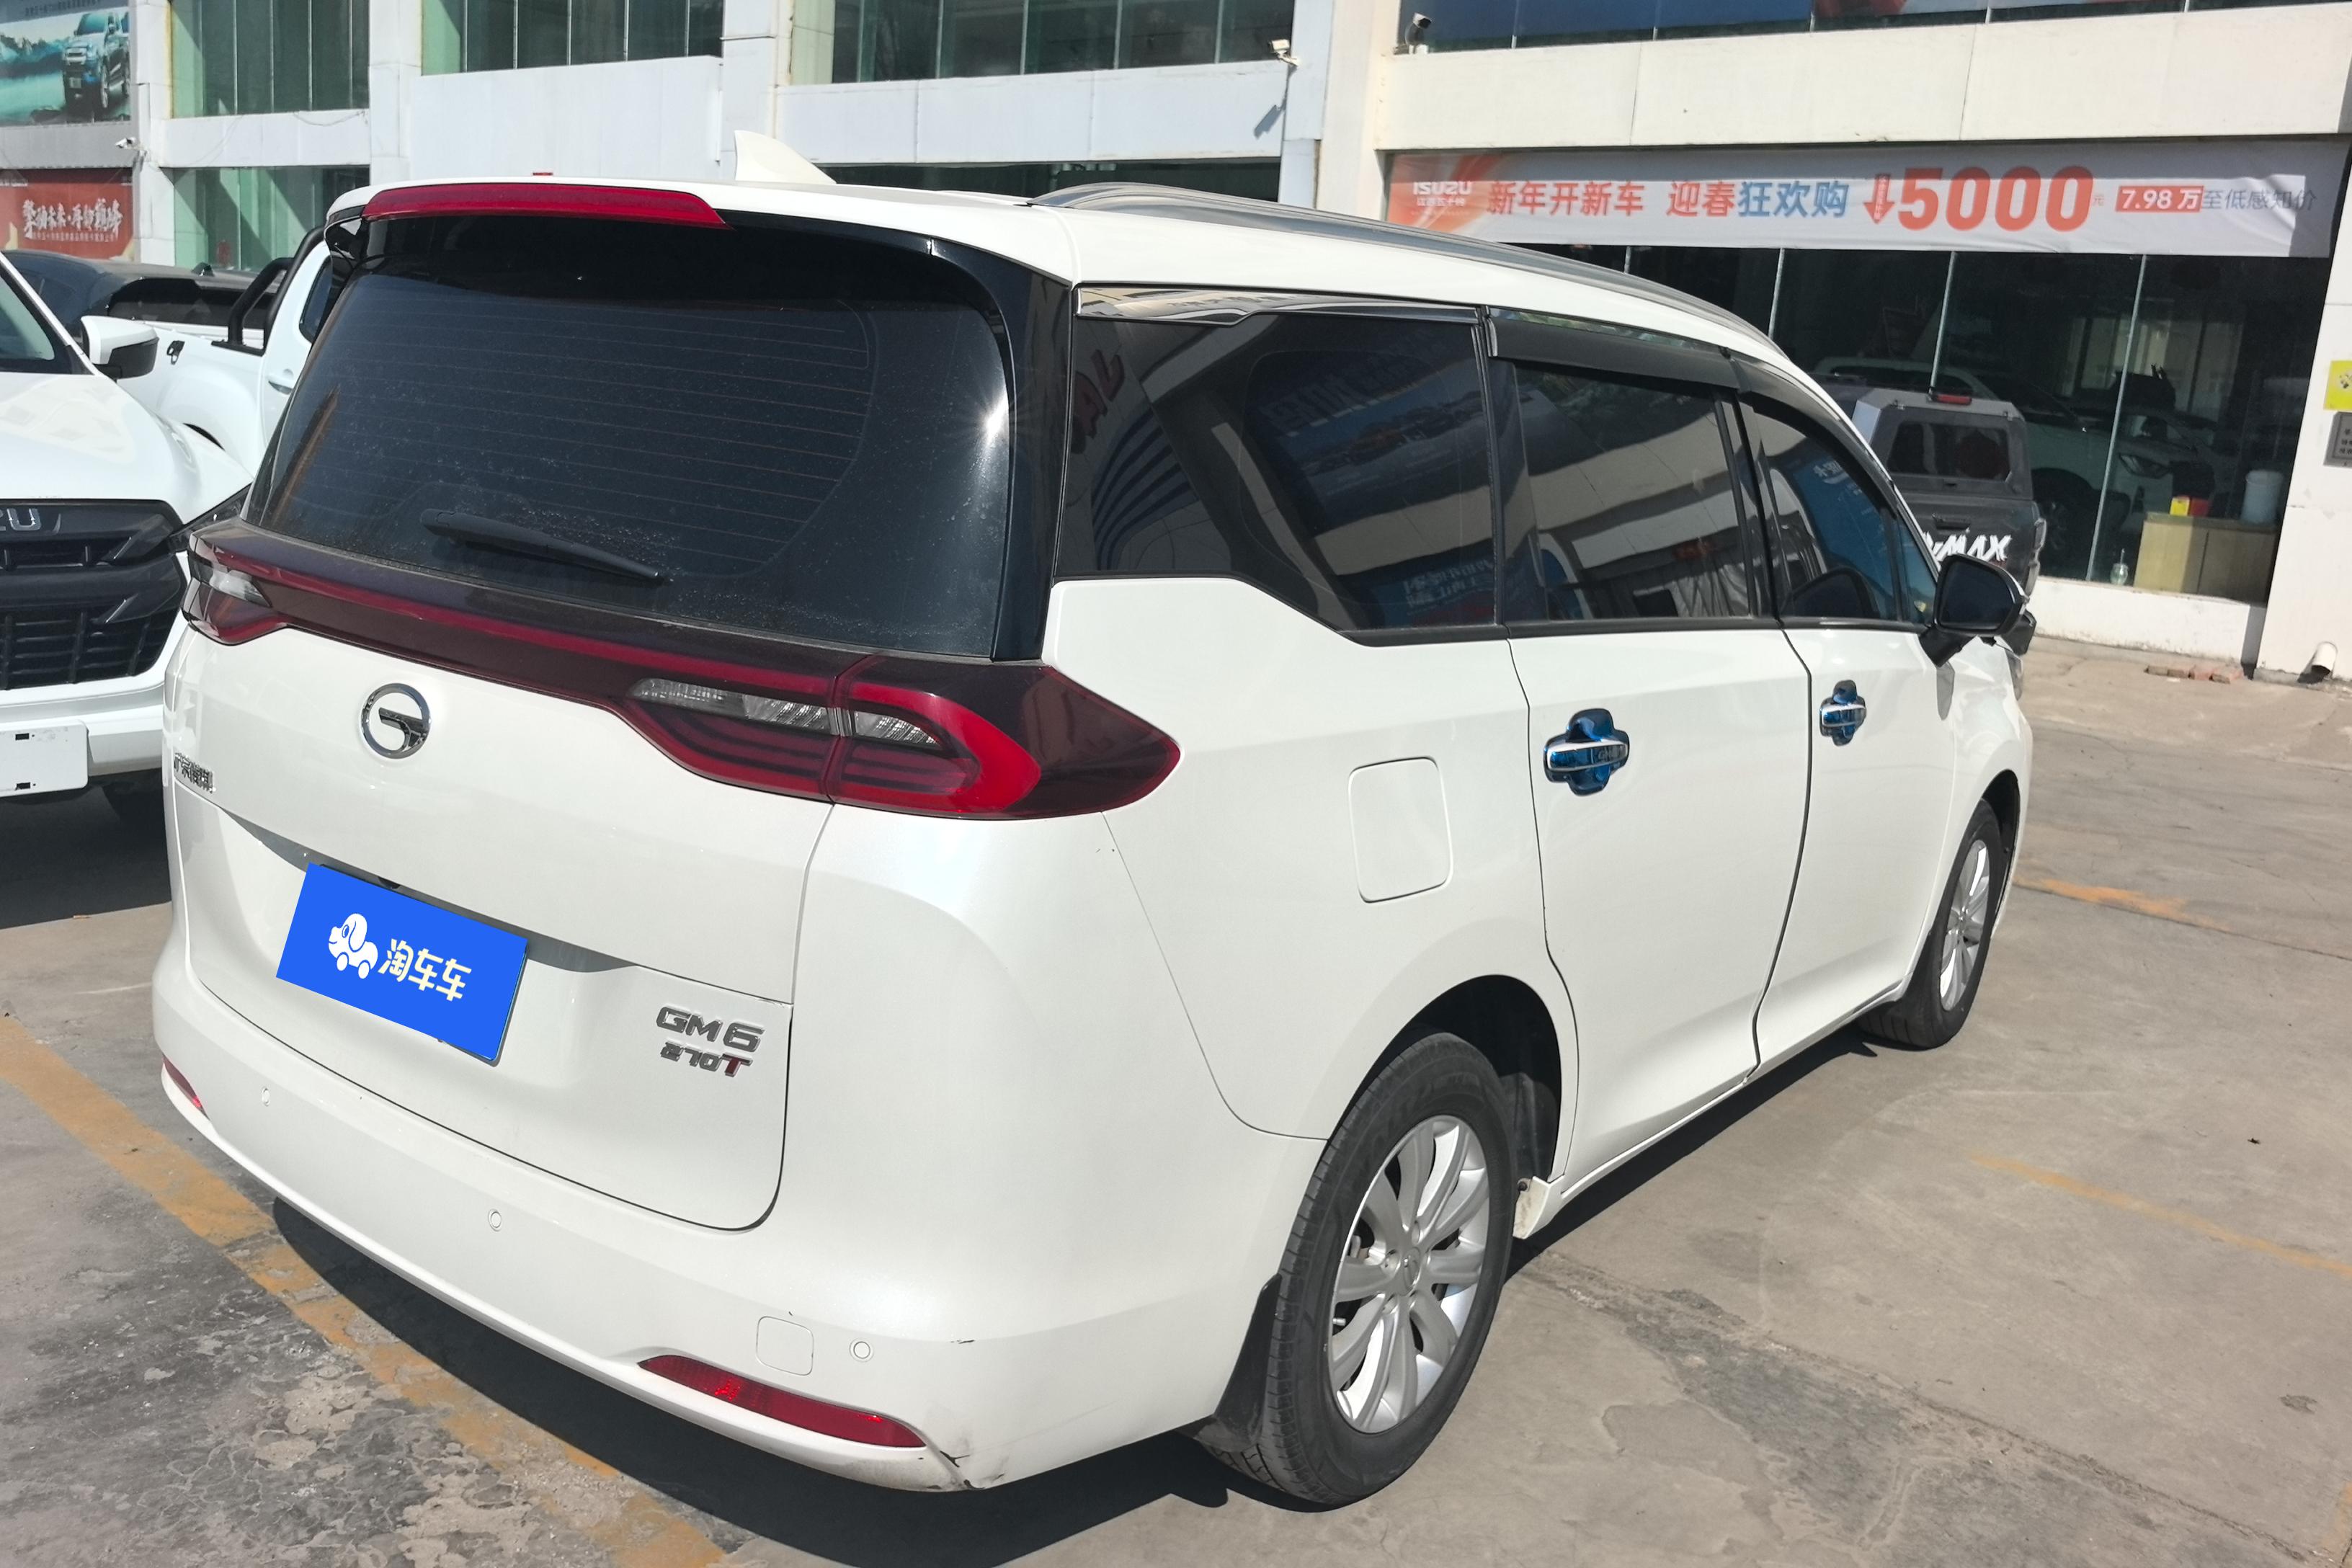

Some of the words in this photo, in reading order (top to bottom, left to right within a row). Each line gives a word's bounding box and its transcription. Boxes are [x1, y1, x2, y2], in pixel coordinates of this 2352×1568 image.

[1413, 180, 1472, 195] ISUZU
[1487, 180, 1644, 215] 新年开新车
[1666, 179, 1850, 218] 迎春狂欢购
[1898, 166, 2093, 232] 5000
